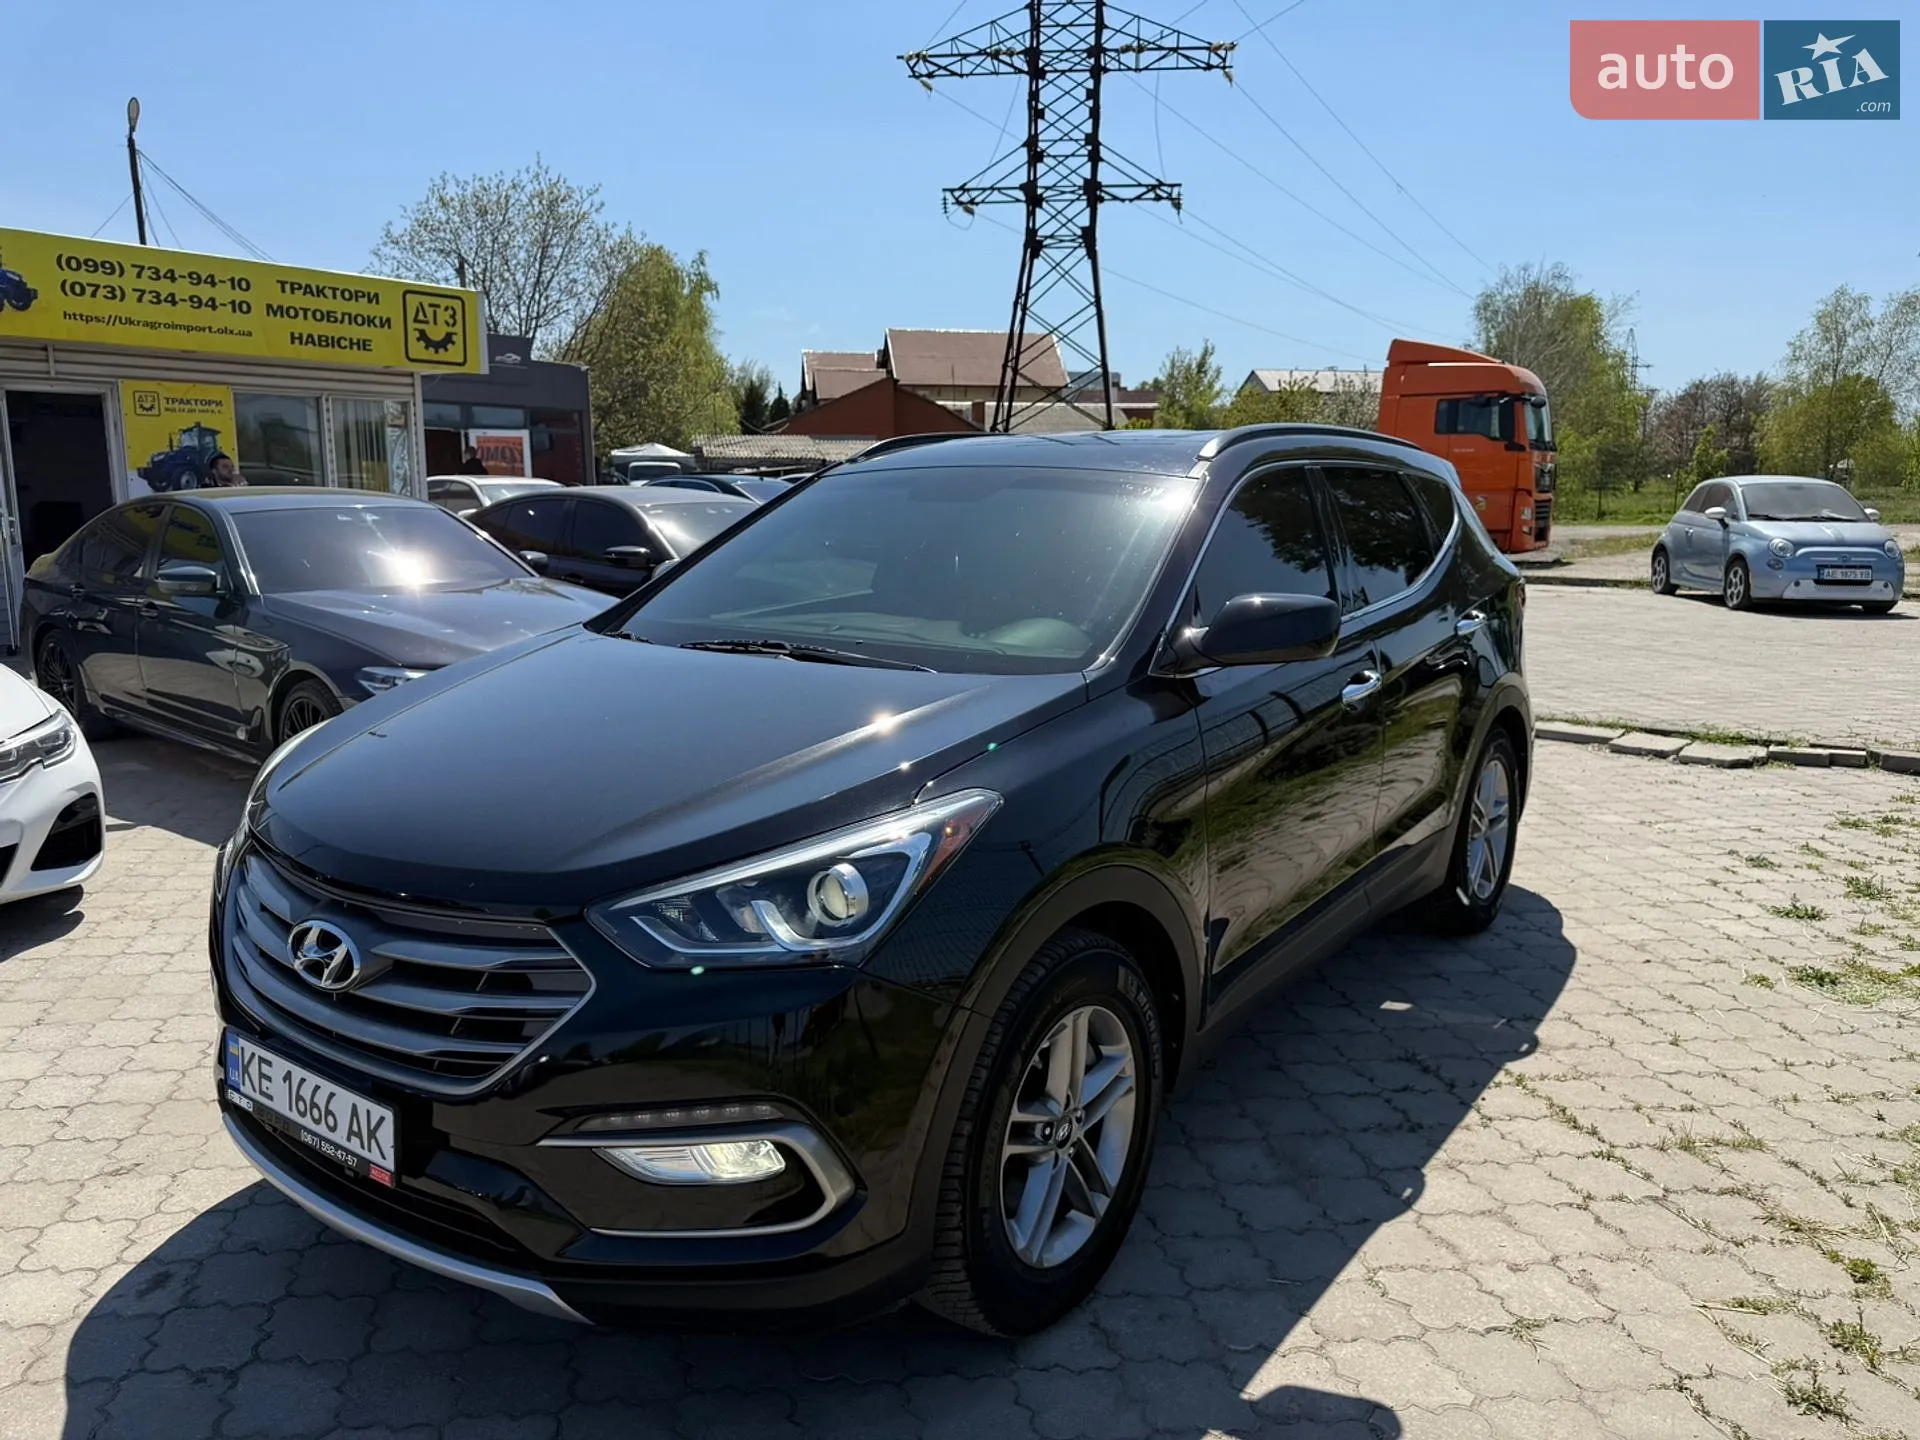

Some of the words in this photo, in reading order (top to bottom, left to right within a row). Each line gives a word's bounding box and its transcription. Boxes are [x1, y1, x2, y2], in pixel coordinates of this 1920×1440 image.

[56, 253, 126, 279] (099)
[131, 263, 252, 292] 734-94-10
[60, 279, 127, 303] (073)
[132, 288, 253, 315] 734-94-10
[276, 279, 381, 306] ТРАКТОРИ
[63, 310, 253, 337] https://Ukragroimport.olx.ua
[265, 303, 392, 331] МОТОБЛОКИ
[289, 332, 374, 353] НАВІСНЕ
[163, 396, 224, 408] ТРАКТОРИ
[240, 1046, 275, 1102] KE
[282, 1069, 338, 1134] 1666
[346, 1103, 387, 1161] AK
